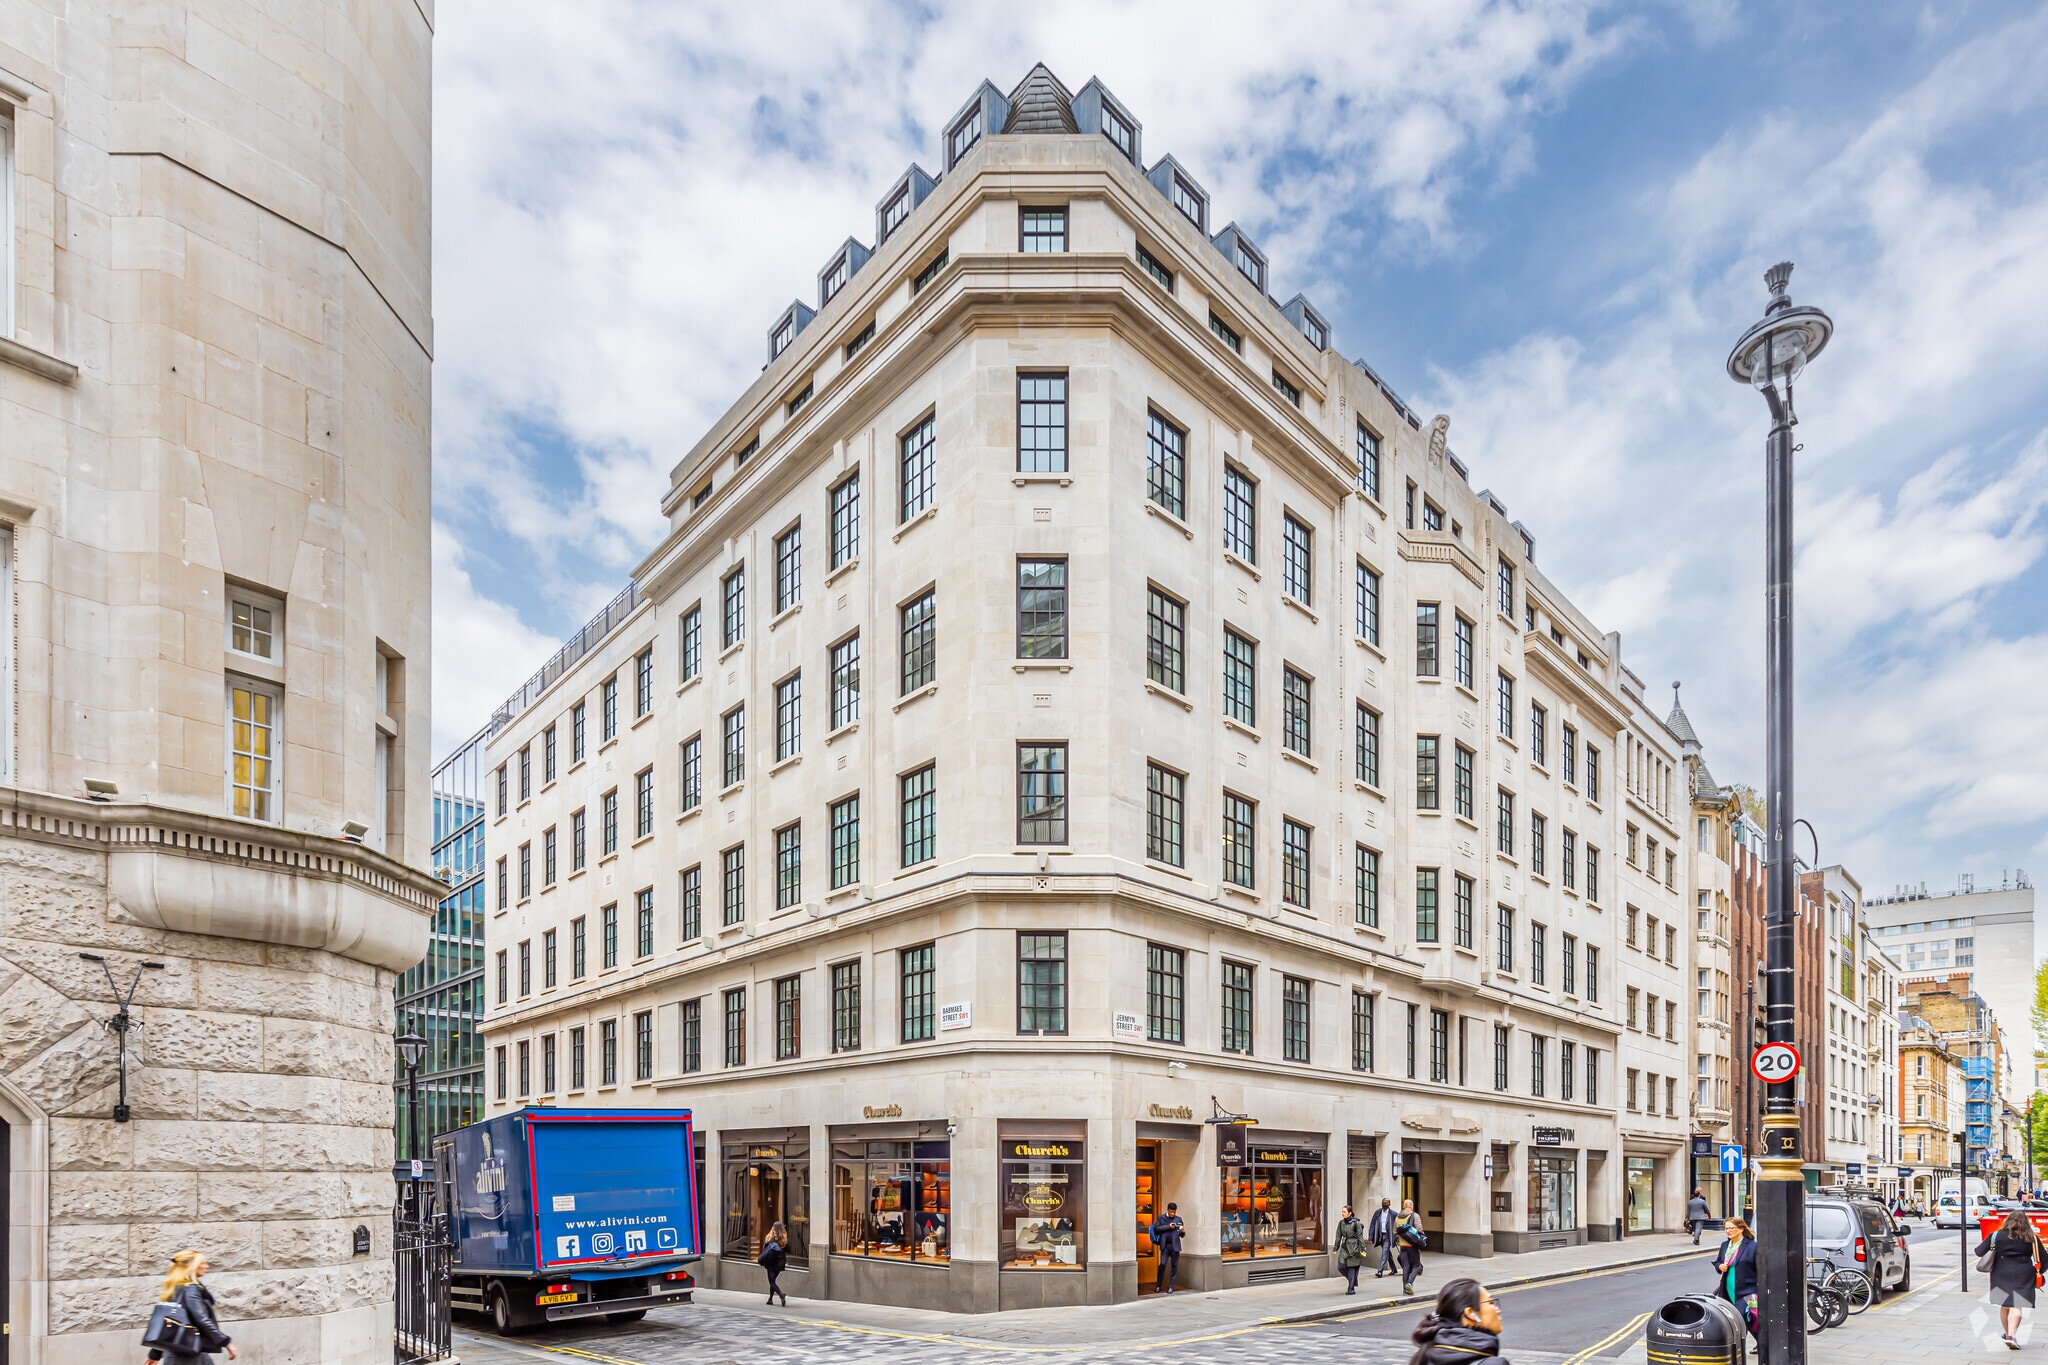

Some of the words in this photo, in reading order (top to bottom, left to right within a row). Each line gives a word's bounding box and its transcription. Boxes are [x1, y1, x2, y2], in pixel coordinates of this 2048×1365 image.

[942, 1005, 963, 1014] BABMAES
[942, 1013, 958, 1022] STREET
[1116, 1014, 1136, 1023] JERMYN
[1116, 1021, 1133, 1031] STREET
[1133, 1024, 1143, 1032] SW1
[1760, 1053, 1794, 1072] 20
[863, 1104, 902, 1118] Church's
[1149, 1103, 1193, 1119] Church's
[755, 1149, 778, 1157] Church's
[1015, 1145, 1069, 1156] Church's
[1220, 1153, 1242, 1161] Church's
[1261, 1151, 1288, 1161] Church's
[476, 1158, 506, 1194] alivini
[1025, 1197, 1061, 1205] Church's
[565, 1215, 668, 1230] www.alivini.com
